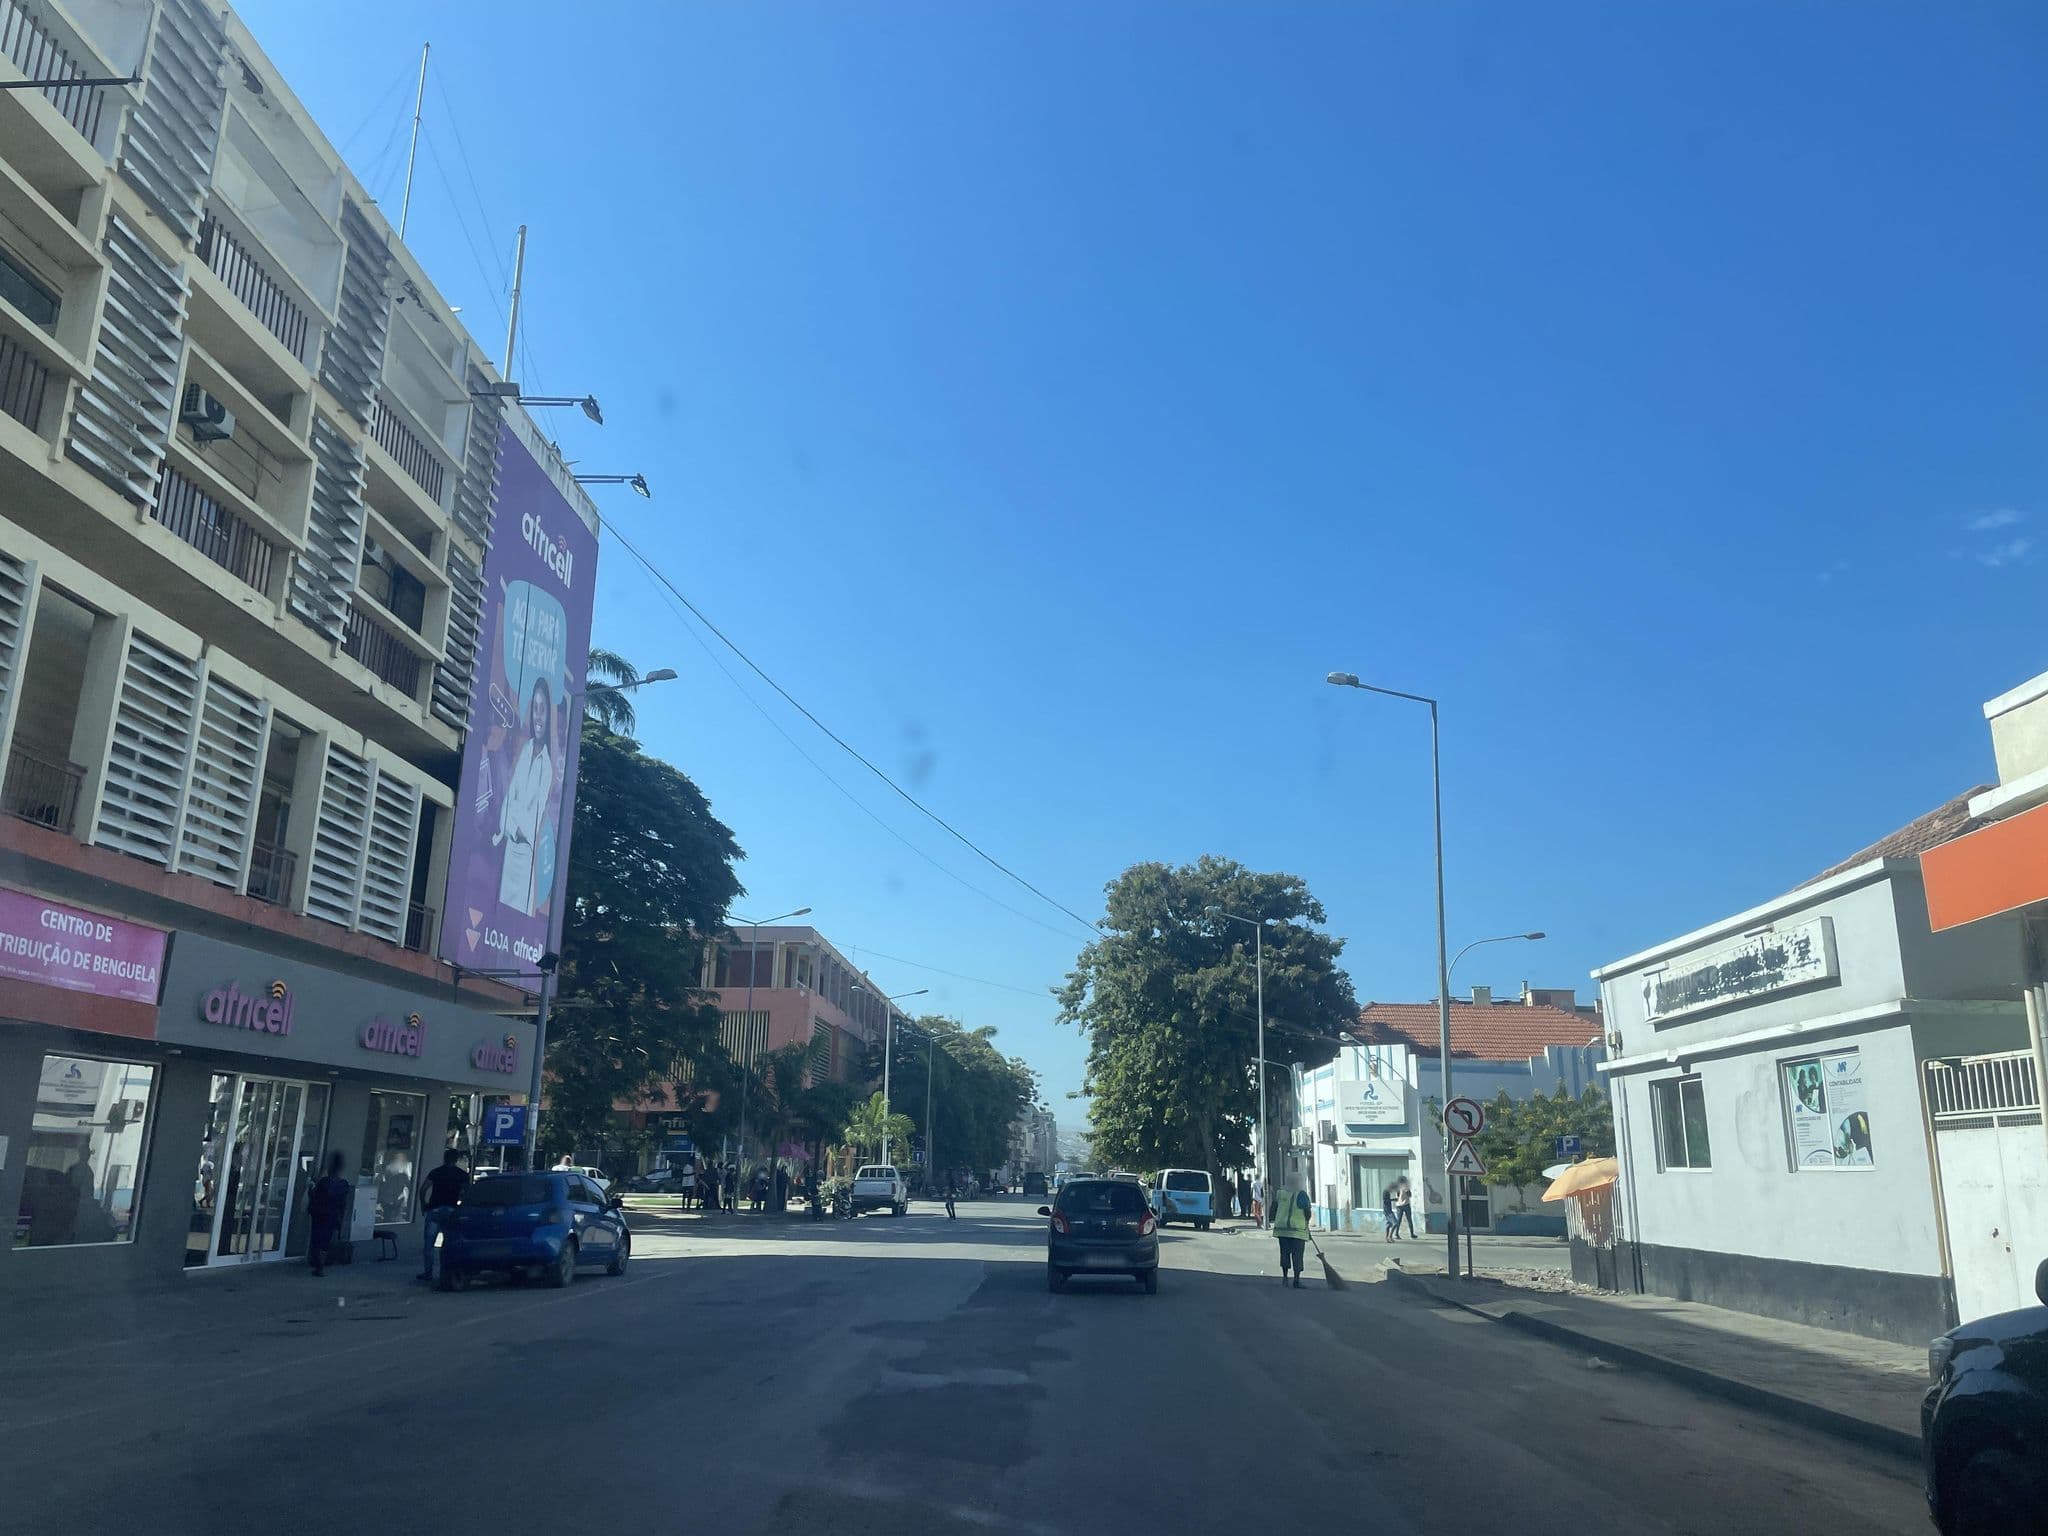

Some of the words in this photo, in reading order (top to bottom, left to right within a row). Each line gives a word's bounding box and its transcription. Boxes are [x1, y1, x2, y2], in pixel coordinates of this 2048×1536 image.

[521, 512, 573, 589] africell
[537, 609, 560, 645] PARA
[40, 909, 94, 938] CENTRO
[95, 923, 113, 943] DE
[484, 927, 509, 952] LOJA
[513, 936, 543, 964] africell
[73, 950, 92, 970] DE
[93, 955, 157, 983] BENGUELA
[204, 980, 294, 1035] africell
[365, 1015, 426, 1057] africell
[475, 1038, 518, 1073] africell
[495, 1114, 514, 1137] P
[1563, 1136, 1574, 1151] P
